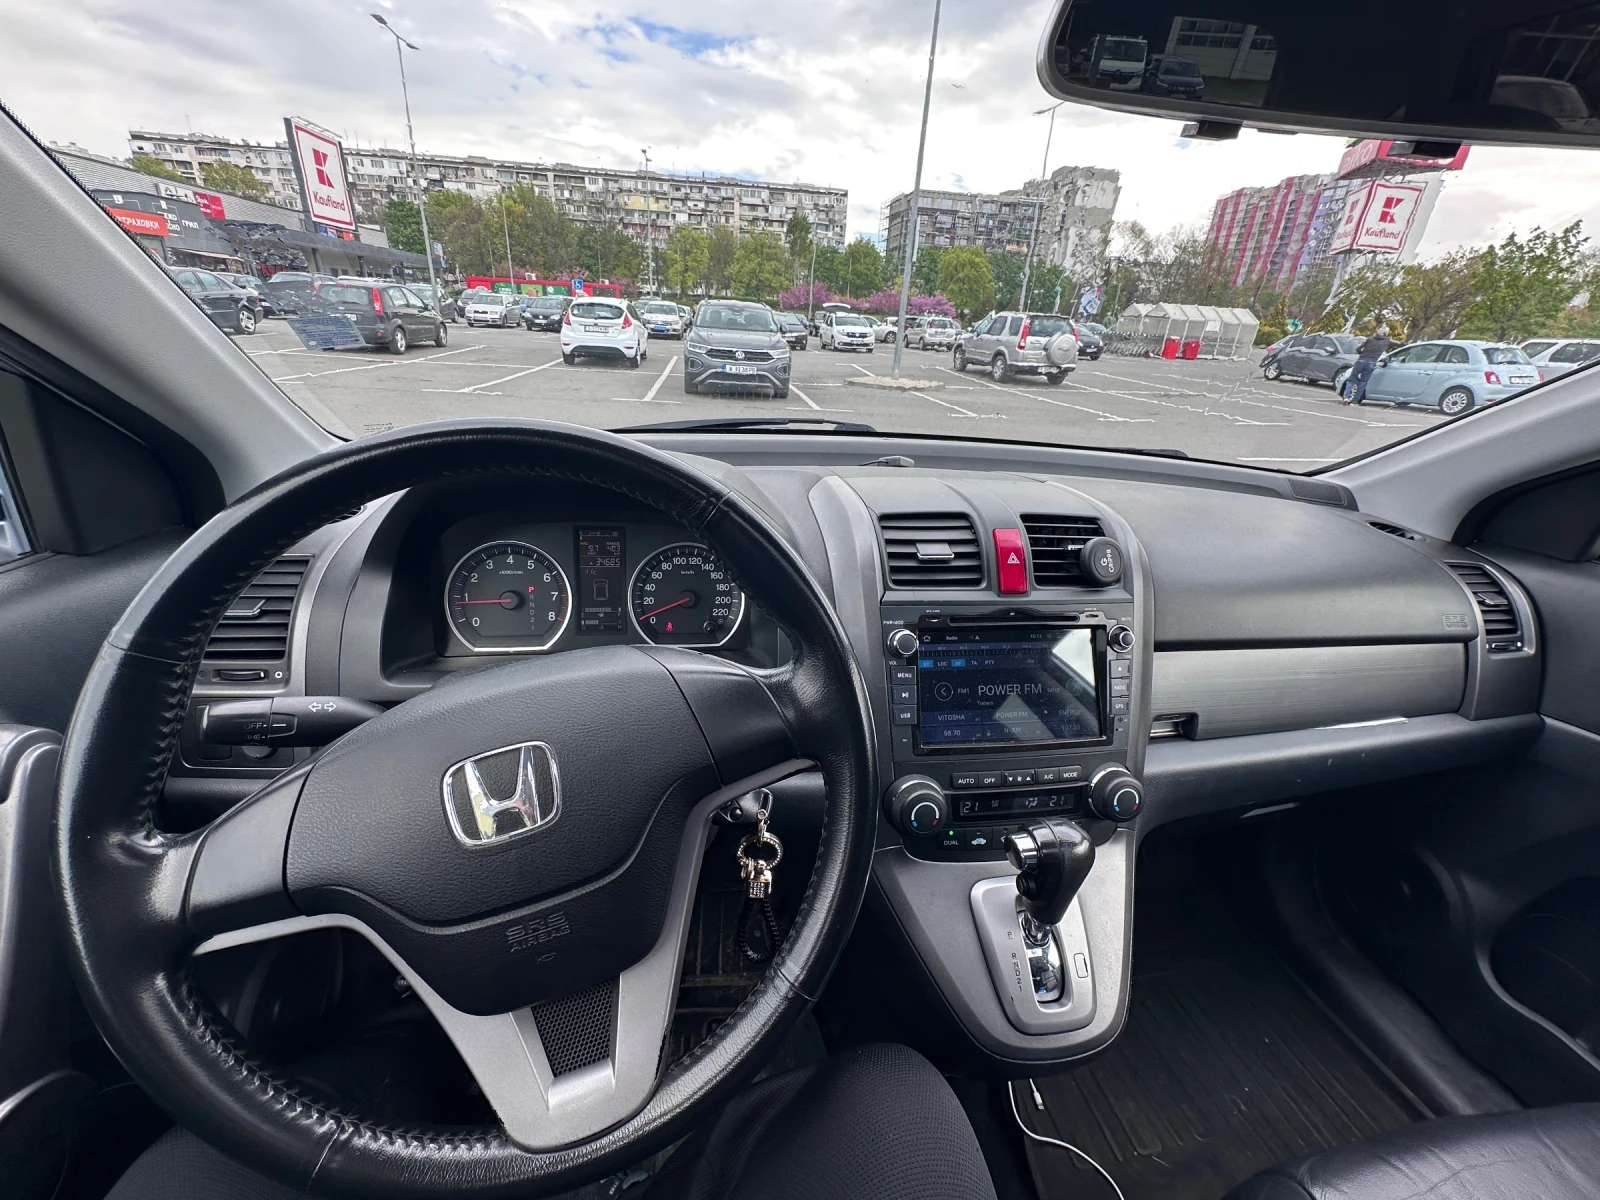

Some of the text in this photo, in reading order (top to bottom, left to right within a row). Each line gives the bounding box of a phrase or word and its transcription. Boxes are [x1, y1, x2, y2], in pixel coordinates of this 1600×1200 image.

[313, 191, 346, 211] Kaufland
[182, 220, 199, 229] ГРИЛ
[1364, 228, 1400, 240] Kaufland
[506, 555, 514, 564] 4
[486, 560, 494, 569] 3
[528, 561, 534, 569] 5
[471, 573, 478, 582] 2
[544, 573, 551, 582] 6
[551, 592, 559, 601] 7
[548, 612, 556, 621] 8
[473, 617, 479, 626] 0
[978, 684, 1042, 696] POWER FM
[1049, 796, 1064, 807] 21
[964, 802, 979, 813] 21
[506, 911, 566, 940] SRS
[511, 925, 570, 952] AIRBAG
